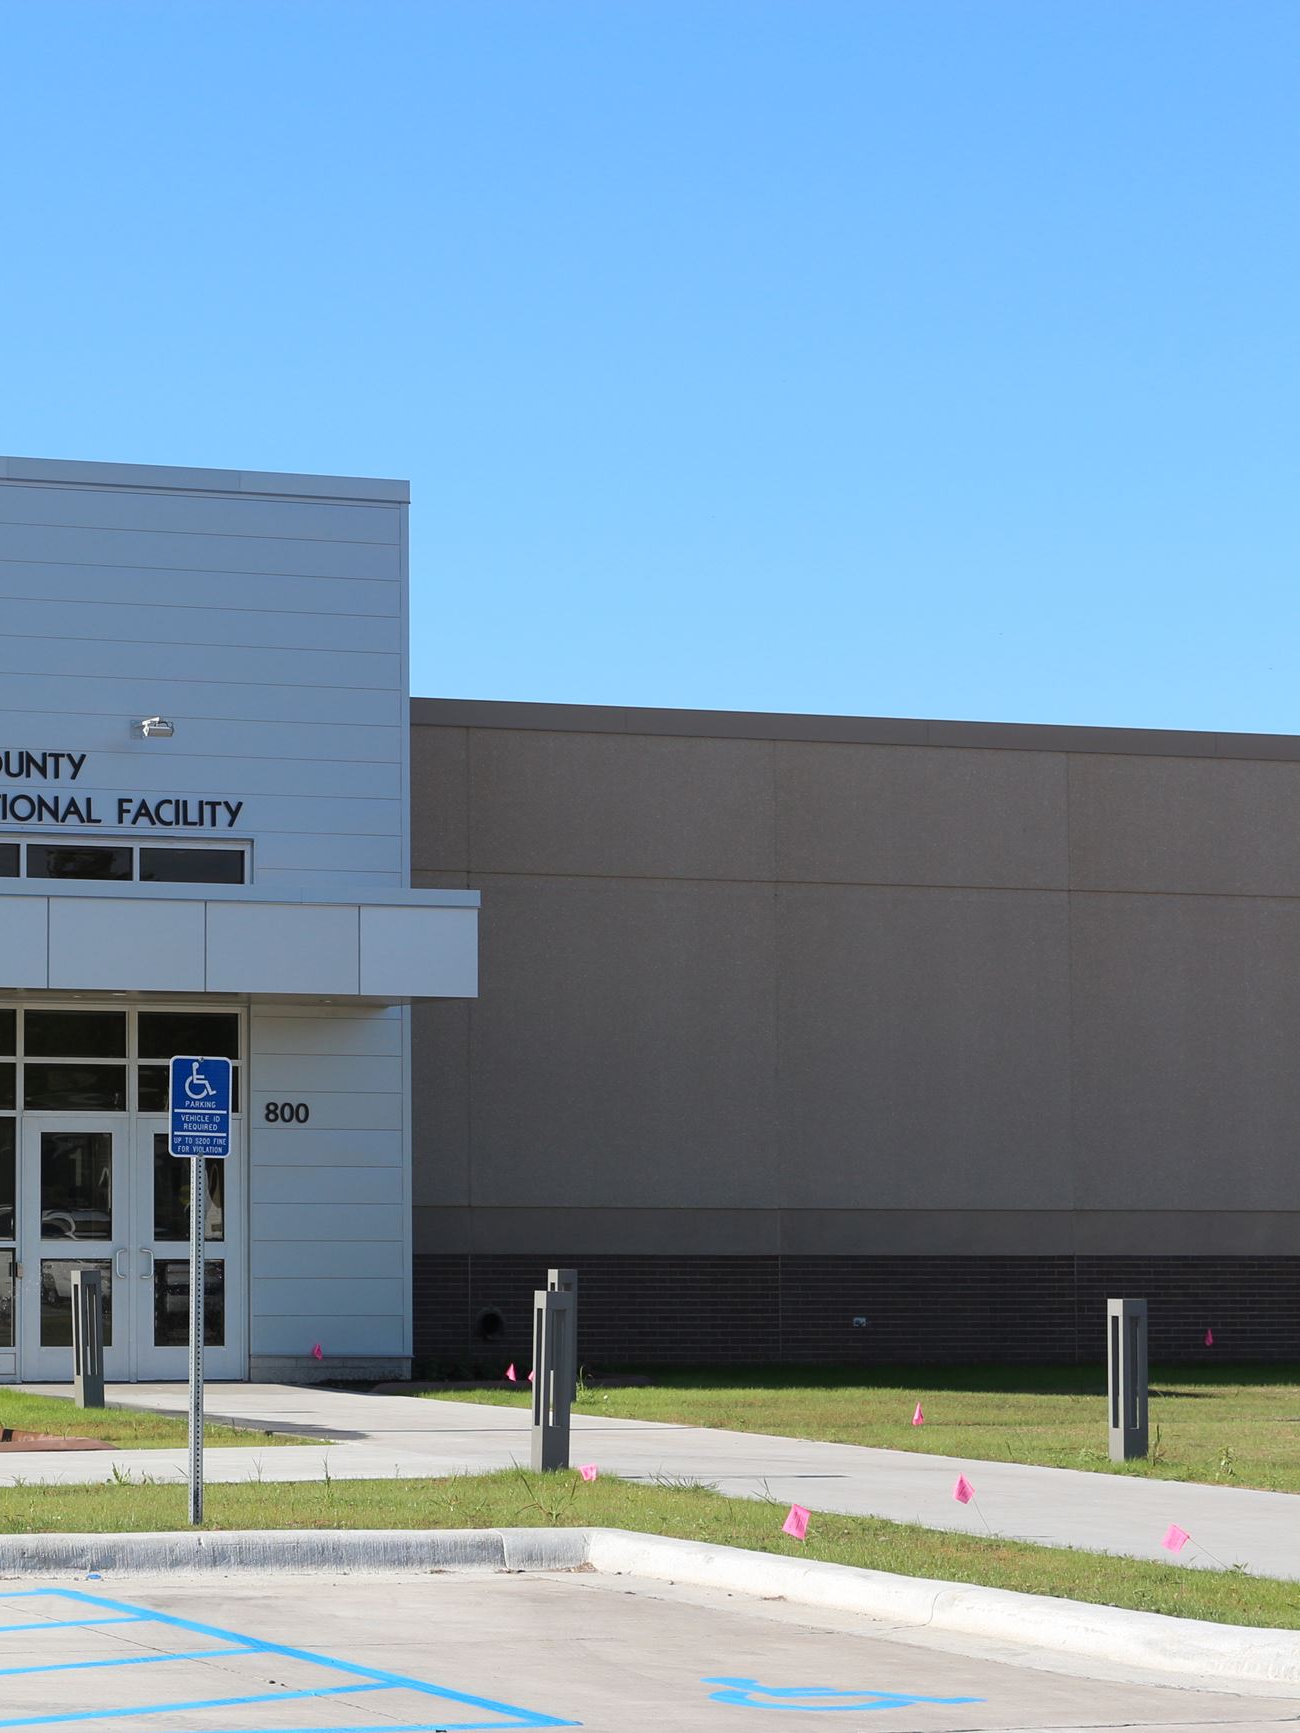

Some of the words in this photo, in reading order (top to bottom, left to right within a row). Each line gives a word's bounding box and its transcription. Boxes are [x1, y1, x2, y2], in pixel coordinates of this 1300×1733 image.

[117, 798, 243, 828] FACILITY
[185, 1100, 216, 1108] PARKING
[264, 1102, 309, 1124] 800
[181, 1114, 209, 1122] VEHICLE
[183, 1122, 218, 1131] REQUIRED
[173, 1136, 182, 1144] UP
[213, 1138, 227, 1146] FINE
[177, 1145, 189, 1153] FOR
[192, 1146, 223, 1154] VIOLATION
